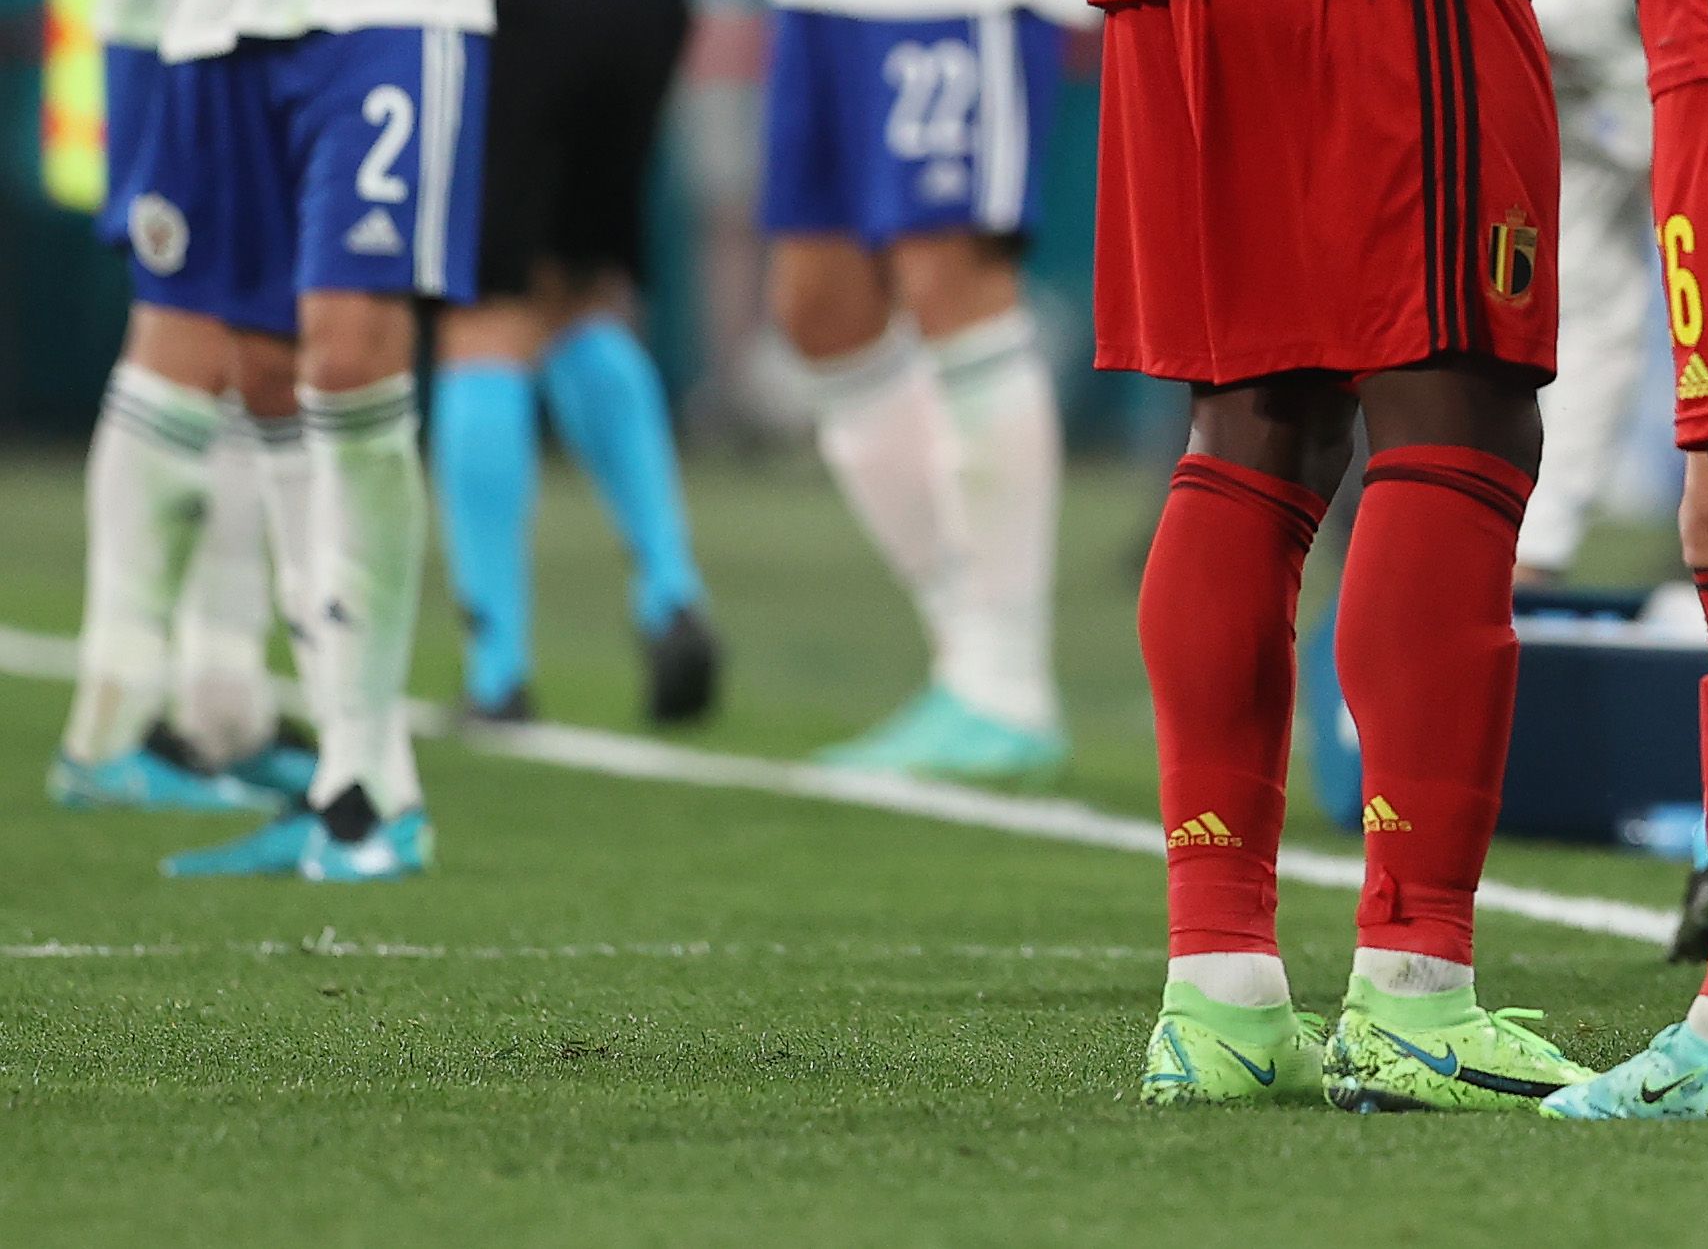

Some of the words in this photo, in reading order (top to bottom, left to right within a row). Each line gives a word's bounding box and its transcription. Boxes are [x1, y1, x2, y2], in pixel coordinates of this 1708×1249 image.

[356, 85, 414, 203] 2
[883, 38, 978, 161] 22
[1656, 213, 1704, 348] 6
